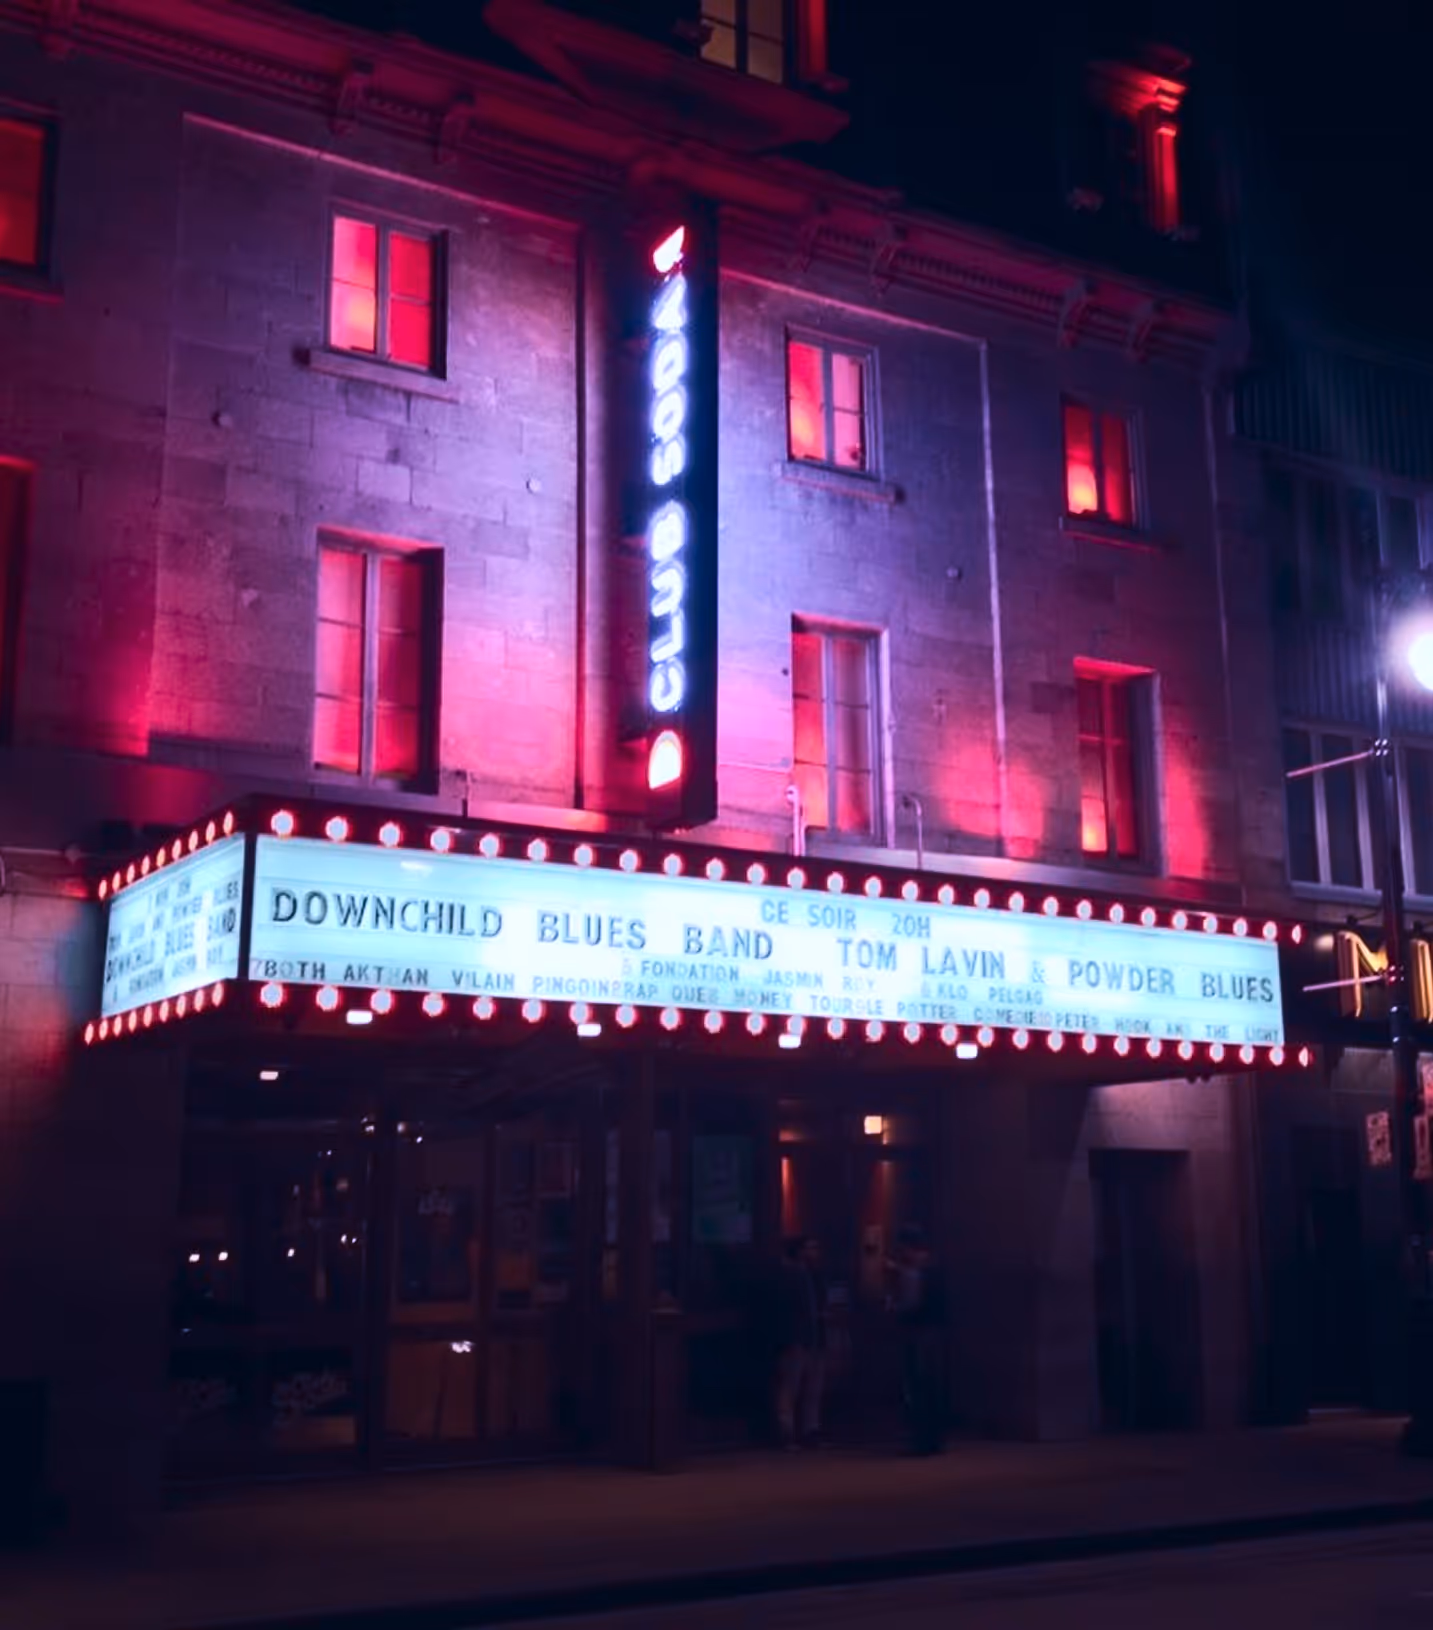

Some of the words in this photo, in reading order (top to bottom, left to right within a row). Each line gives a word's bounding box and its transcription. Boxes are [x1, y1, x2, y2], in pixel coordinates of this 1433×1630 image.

[651, 275, 687, 485] SODA
[650, 500, 686, 712] CLUB
[271, 887, 504, 938] DOWNCHILD
[537, 909, 647, 951] BLUES
[683, 922, 774, 961] BAND
[836, 936, 898, 972] TOM
[921, 945, 1006, 980] LAVIN
[1068, 959, 1177, 996] POWDER
[1200, 970, 1274, 1004] BLUES
[640, 959, 740, 982] FONDATION
[763, 969, 824, 990] JASMIN
[761, 899, 789, 925] CE
[807, 904, 857, 931] SOIR
[891, 912, 932, 939] 20H
